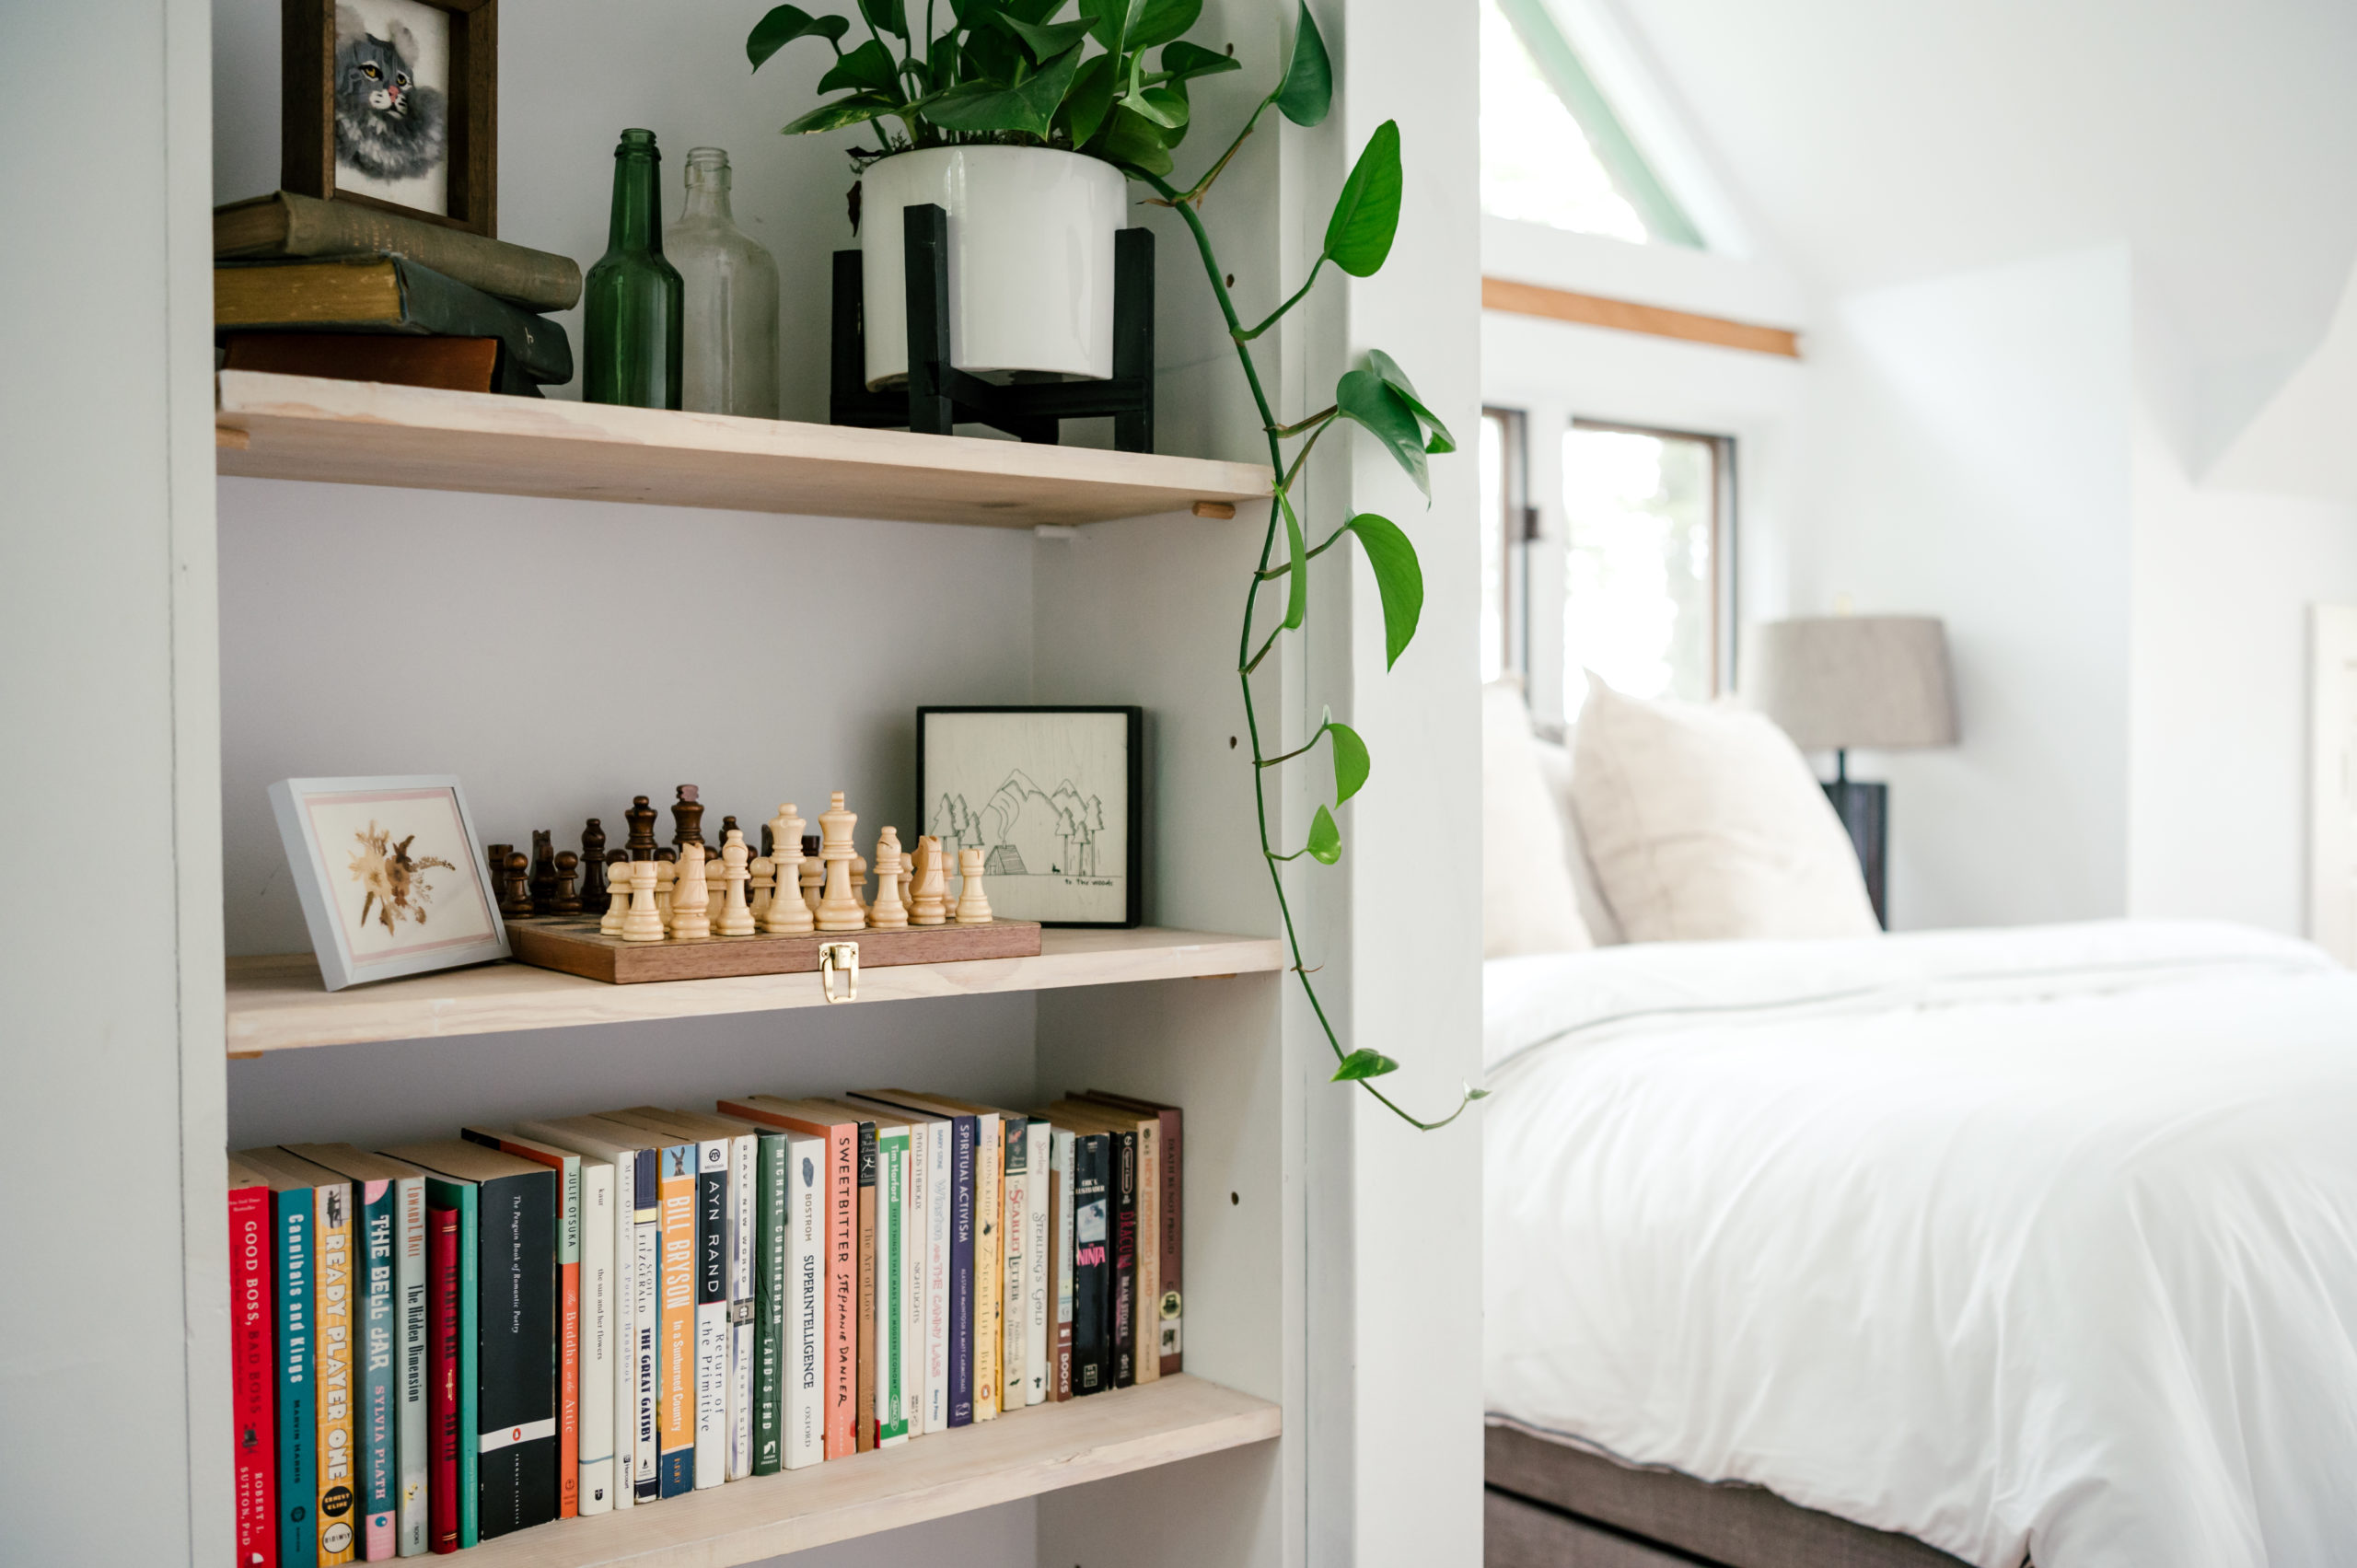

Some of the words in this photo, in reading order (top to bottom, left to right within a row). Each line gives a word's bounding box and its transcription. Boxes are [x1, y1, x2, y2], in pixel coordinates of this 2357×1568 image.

[890, 1144, 900, 1162] Tim
[959, 1124, 970, 1183] SPIRITUAL
[1035, 1140, 1047, 1176] Sterling
[1144, 1157, 1154, 1188] NEW
[1167, 1138, 1175, 1174] DEATH
[568, 1171, 577, 1202] JULIE
[708, 1180, 720, 1221] AYN
[775, 1148, 784, 1215] MICHAEL
[838, 1137, 850, 1262] SWEETBITTER
[890, 1165, 900, 1202] Harford
[1167, 1177, 1175, 1188] BE
[667, 1195, 691, 1234] BILL
[934, 1179, 946, 1241] Winston
[959, 1186, 970, 1243] ACTIVISM
[1008, 1189, 1024, 1252] SCARLET
[1066, 1194, 1074, 1219] being
[1167, 1192, 1175, 1214] NOT
[371, 1214, 389, 1260] THE
[512, 1212, 521, 1240] Penguin
[568, 1206, 577, 1248] OTSUKA
[864, 1225, 873, 1249] The
[1118, 1211, 1134, 1270] DRACULA
[1144, 1191, 1154, 1259] PROMISED
[1167, 1217, 1175, 1255] PROUD
[245, 1221, 258, 1271] GOOD
[288, 1214, 305, 1296] Cannibals
[708, 1235, 720, 1293] RAND
[864, 1253, 873, 1272] Art
[1077, 1246, 1105, 1268] NINJA
[325, 1234, 346, 1317] READY
[512, 1263, 520, 1272] of
[638, 1235, 646, 1313] FITZGERALD
[667, 1238, 691, 1309] BRYSON
[773, 1225, 784, 1324] CUNNINGHAM
[864, 1276, 873, 1288] of
[933, 1263, 943, 1290] THE
[1008, 1252, 1022, 1301] LETTER
[1144, 1261, 1154, 1297] LAND
[245, 1278, 259, 1326] BOSS,
[371, 1265, 389, 1320] BELL
[407, 1283, 424, 1304] The
[567, 1289, 576, 1306] The
[623, 1277, 632, 1316] Poetry
[837, 1273, 850, 1341] STEPHANIE
[864, 1292, 873, 1320] Love
[1121, 1276, 1130, 1302] BRAM
[289, 1302, 305, 1331] and
[408, 1306, 424, 1342] Hidden
[512, 1310, 521, 1333] Poetry
[673, 1319, 684, 1331] In
[702, 1320, 714, 1346] the
[803, 1255, 814, 1389] SUPERINTELLIGENCE
[1120, 1303, 1129, 1337] STOKER
[249, 1330, 260, 1365] BAD
[369, 1327, 389, 1372] JAR
[566, 1311, 576, 1365] Buddha
[641, 1327, 651, 1351] THE
[288, 1337, 305, 1383] Kings
[326, 1325, 347, 1423] PLAYER
[408, 1344, 424, 1402] Dimension
[641, 1354, 651, 1393] GREAT
[673, 1340, 684, 1392] Sunburned
[714, 1333, 725, 1388] Return
[763, 1338, 773, 1392] LAND'S
[838, 1346, 850, 1407] DANLER
[932, 1343, 941, 1377] LASS
[1060, 1353, 1070, 1393] BOOKS
[250, 1372, 261, 1414] BOSS
[670, 1392, 684, 1432] Country
[701, 1355, 713, 1433] Primitive
[714, 1398, 725, 1414] of
[375, 1385, 385, 1443] SYLVIA
[565, 1399, 575, 1433] Attic
[641, 1397, 651, 1442] GATSBY
[762, 1402, 772, 1429] END
[328, 1428, 348, 1481] ONE
[375, 1448, 386, 1500] PLATH
[240, 1467, 250, 1520] SUTTON,
[255, 1472, 264, 1520] ROBERT
[256, 1526, 264, 1534] L.
